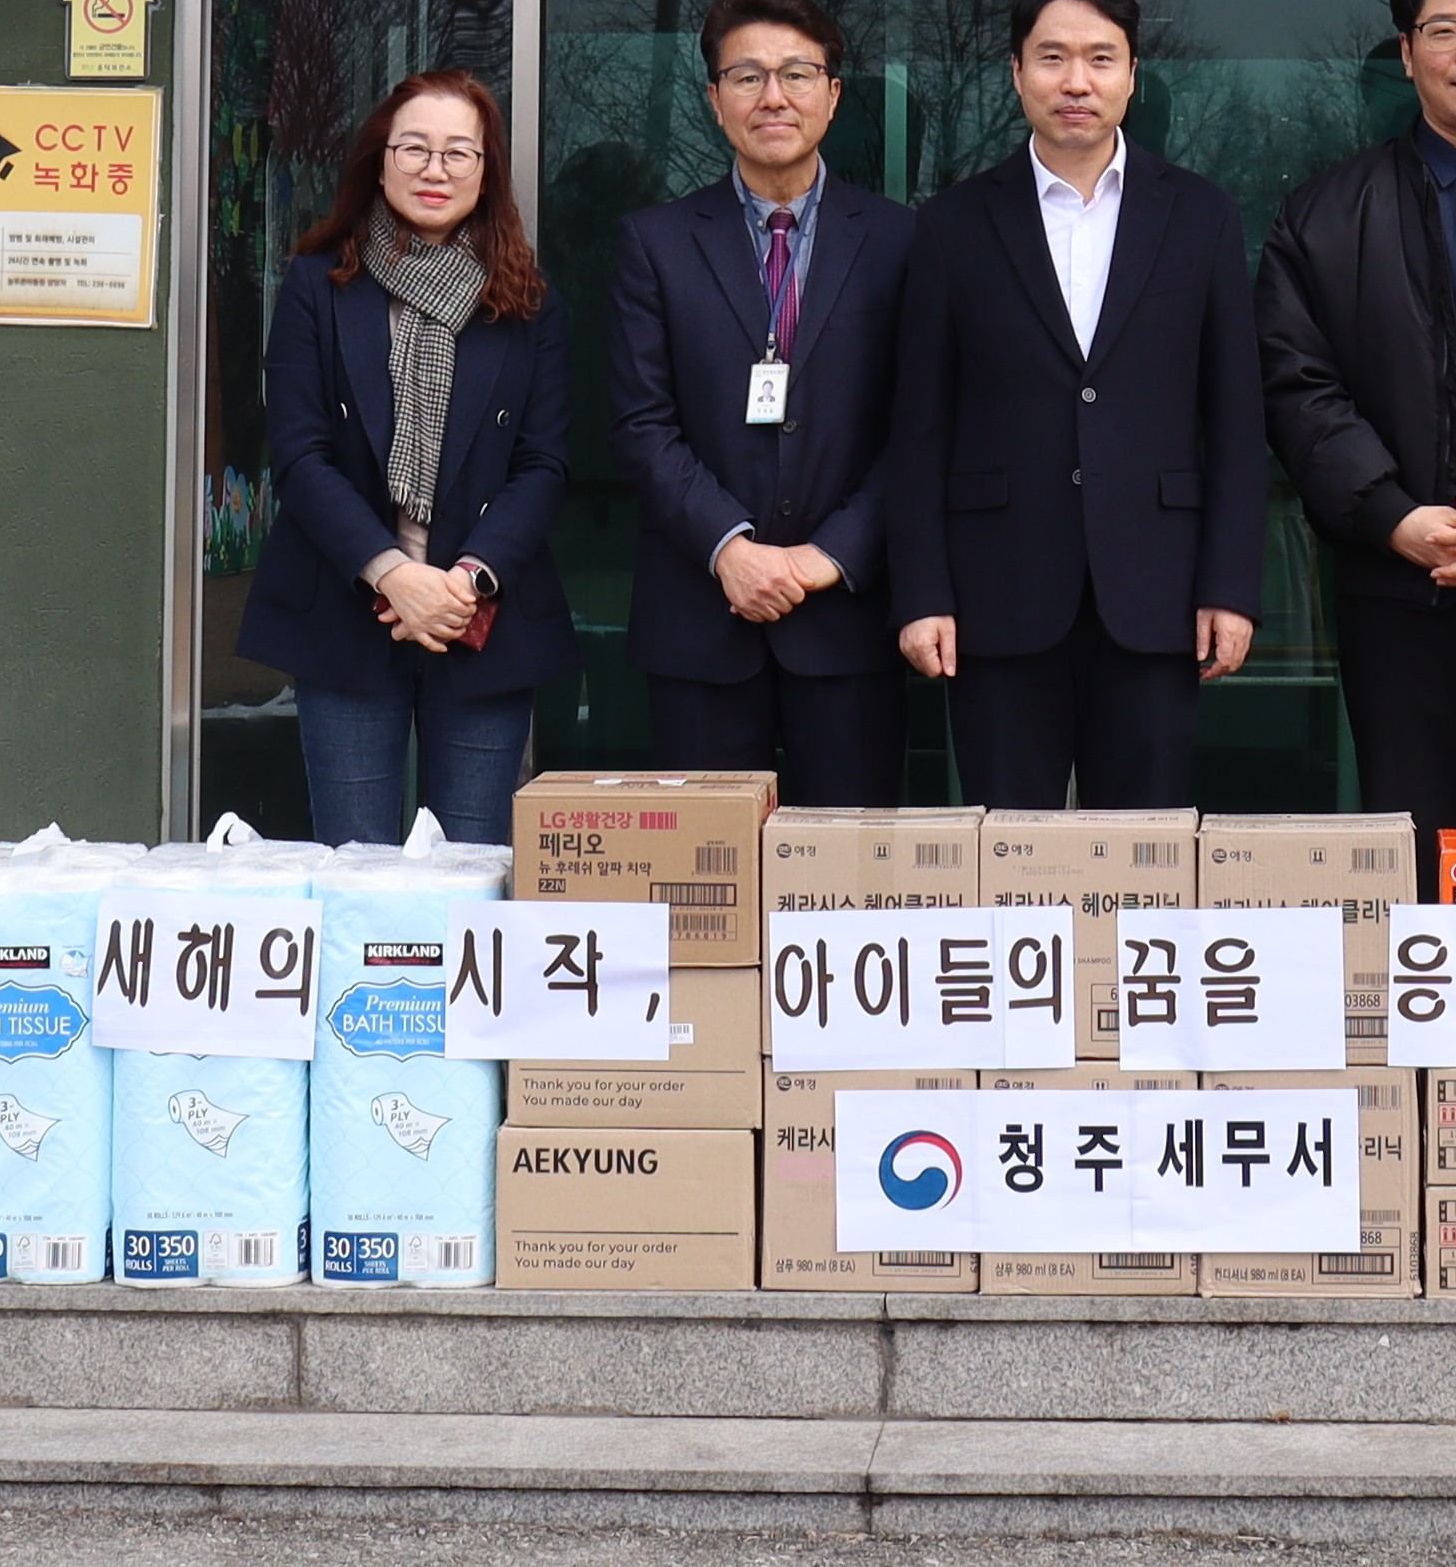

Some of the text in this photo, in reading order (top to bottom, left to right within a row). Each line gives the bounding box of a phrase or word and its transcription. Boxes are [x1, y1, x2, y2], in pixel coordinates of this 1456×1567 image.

[34, 124, 134, 152] CCTV
[33, 162, 134, 196] 녹화중
[538, 833, 605, 858] 페리오
[539, 861, 652, 876] 뉴 후레쉬 알파 치약
[539, 879, 565, 893] 22N
[367, 945, 441, 957] KIRKLAND
[96, 917, 316, 1017] 새해의
[449, 927, 661, 1023] 시작,
[774, 933, 1063, 1030] 아이들의
[1122, 937, 1262, 1028] 꿈을
[366, 994, 442, 1011] Premium
[8, 1016, 72, 1035] TISSUE
[343, 1014, 446, 1033] BATH TISSU
[523, 1078, 685, 1094] Thank you for your order
[522, 1095, 643, 1109] You made our day
[0, 1112, 20, 1123] PLY
[188, 1109, 208, 1119] PLY
[390, 1111, 411, 1122] PLY
[512, 1147, 659, 1175] AEKYUNG
[127, 1235, 150, 1256] 30
[157, 1235, 194, 1257] 350
[327, 1237, 350, 1258] 30
[358, 1237, 394, 1259] 350
[515, 1240, 678, 1255] Thank you for your order
[125, 1258, 152, 1271] ROLLS
[325, 1260, 352, 1273] ROLLS
[515, 1257, 636, 1270] You made our day
[775, 1260, 856, 1274] 샴푸 980 ml (8 EA)
[995, 1263, 1076, 1277] 샴푸 980 ml (8 EA)
[1250, 1267, 1267, 1281] 980
[1268, 1267, 1279, 1281] ml
[1280, 1267, 1290, 1282] (8
[1292, 1267, 1306, 1282] EA)
